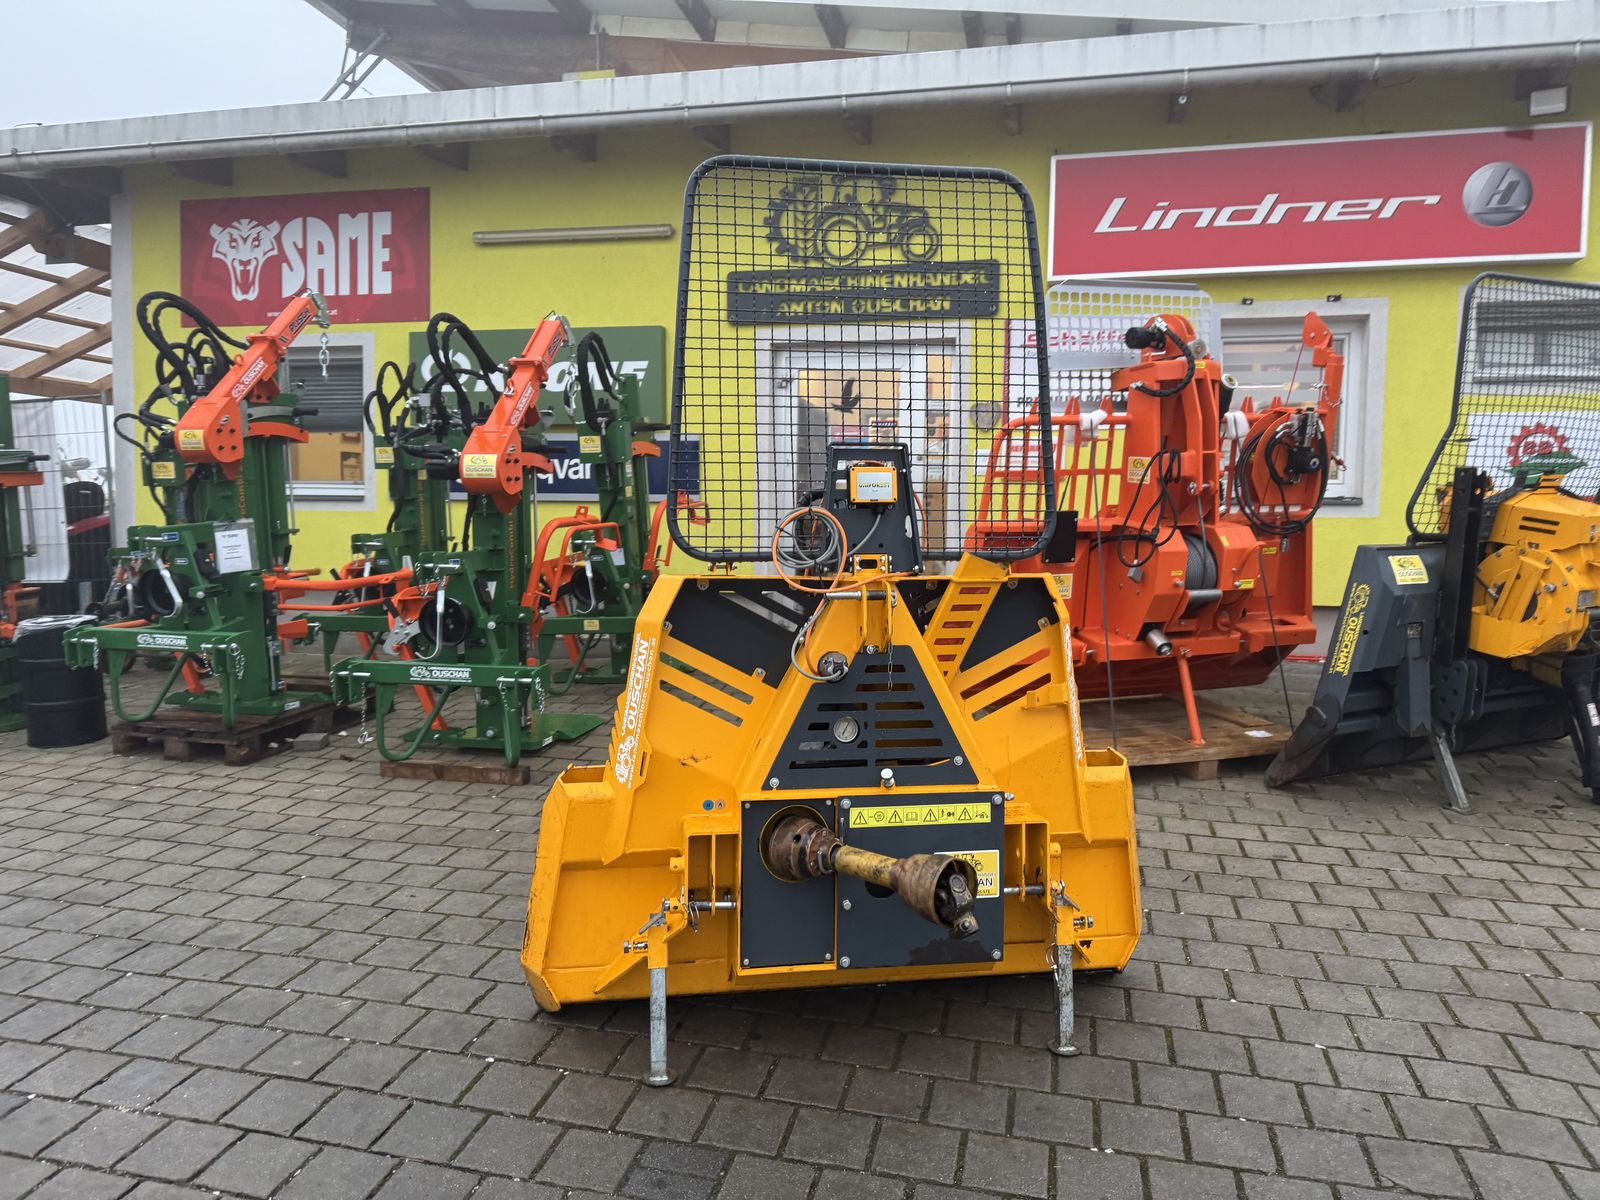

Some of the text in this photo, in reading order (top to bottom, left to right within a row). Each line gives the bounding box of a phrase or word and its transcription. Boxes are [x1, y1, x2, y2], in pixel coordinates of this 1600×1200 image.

[281, 210, 393, 299] SAME
[1094, 192, 1441, 234] Lindner
[432, 670, 469, 678] OUSCHAN
[620, 631, 642, 736] LANDMASCHINENHANDEL
[627, 639, 649, 730] OUSCHAN
[1335, 616, 1358, 673] OUSCHAN
[627, 637, 657, 789] www.landmaschinen-ouschan.at
